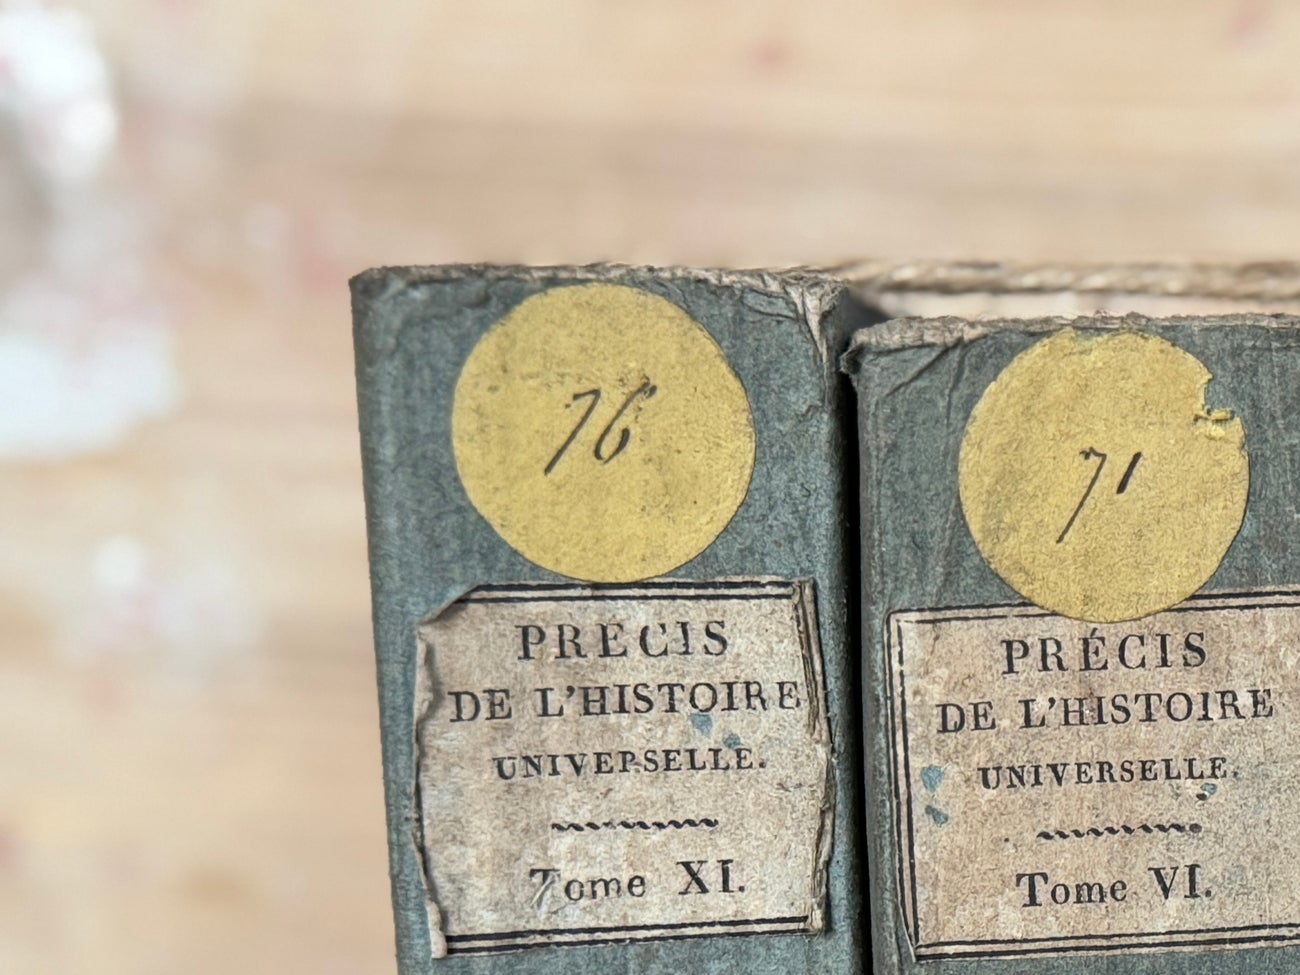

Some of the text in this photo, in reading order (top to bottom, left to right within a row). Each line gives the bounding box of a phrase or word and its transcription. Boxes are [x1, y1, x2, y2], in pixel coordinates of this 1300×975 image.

[544, 377, 658, 476] 76
[1055, 446, 1143, 545] 71
[1000, 628, 1208, 674] PRÉCIS
[447, 689, 513, 722] DE
[935, 701, 997, 734] DE
[492, 748, 768, 780] UNIVERSELLE.
[977, 757, 1238, 790] UNIVERSELLE.
[529, 858, 745, 903] Tome XI.
[1015, 864, 1212, 908] Tome VI.
